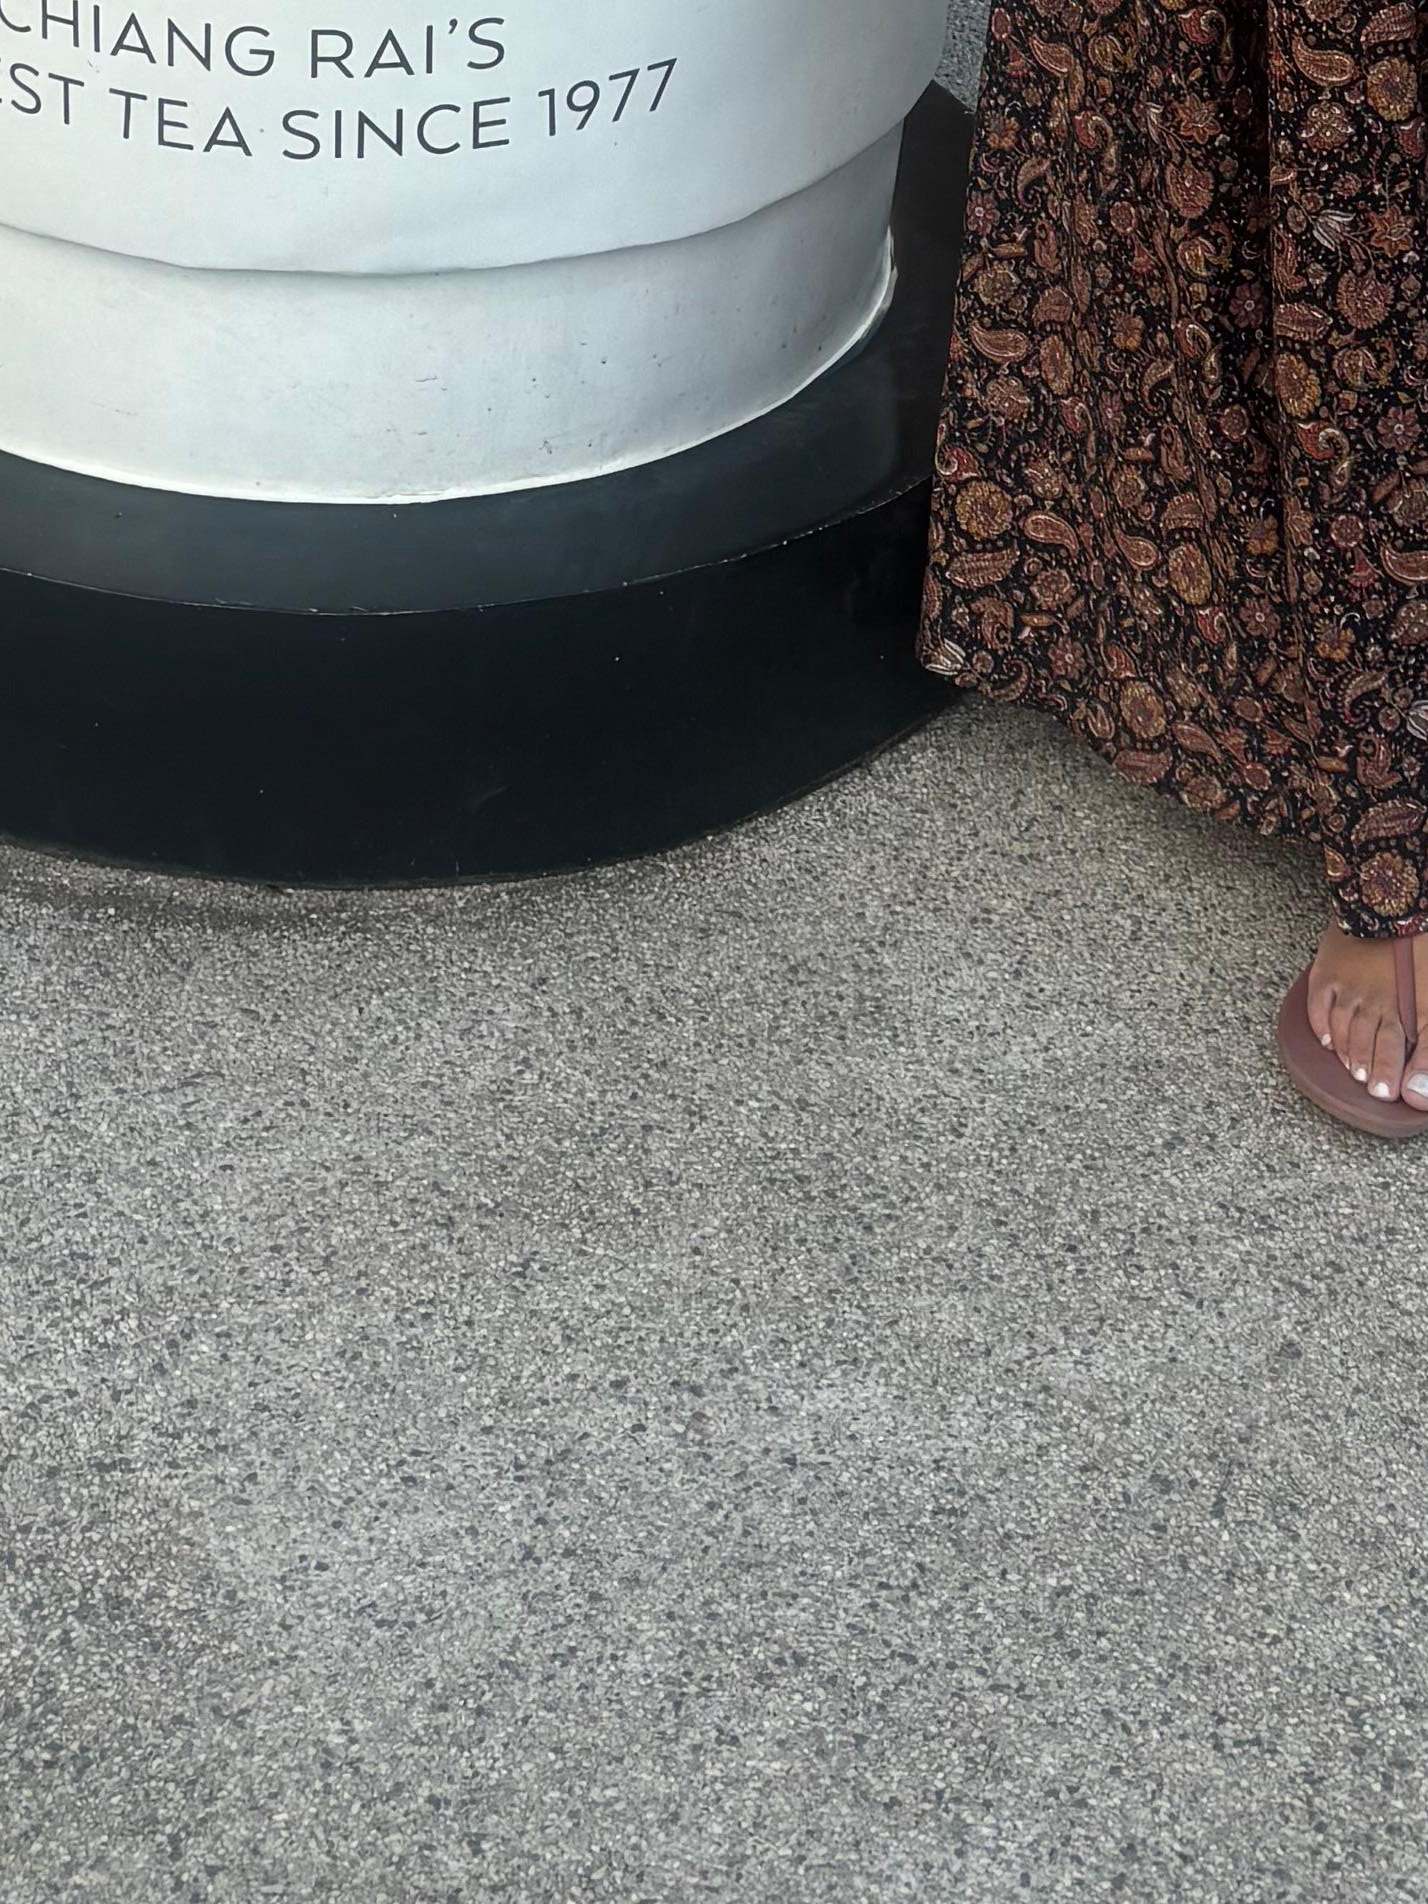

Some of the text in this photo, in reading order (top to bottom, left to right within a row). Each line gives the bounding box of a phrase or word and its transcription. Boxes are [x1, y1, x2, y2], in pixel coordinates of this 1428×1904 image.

[309, 17, 505, 79] RAI'S
[108, 87, 253, 157] TEA
[281, 96, 511, 160] SINCE
[537, 57, 679, 137] 1977
